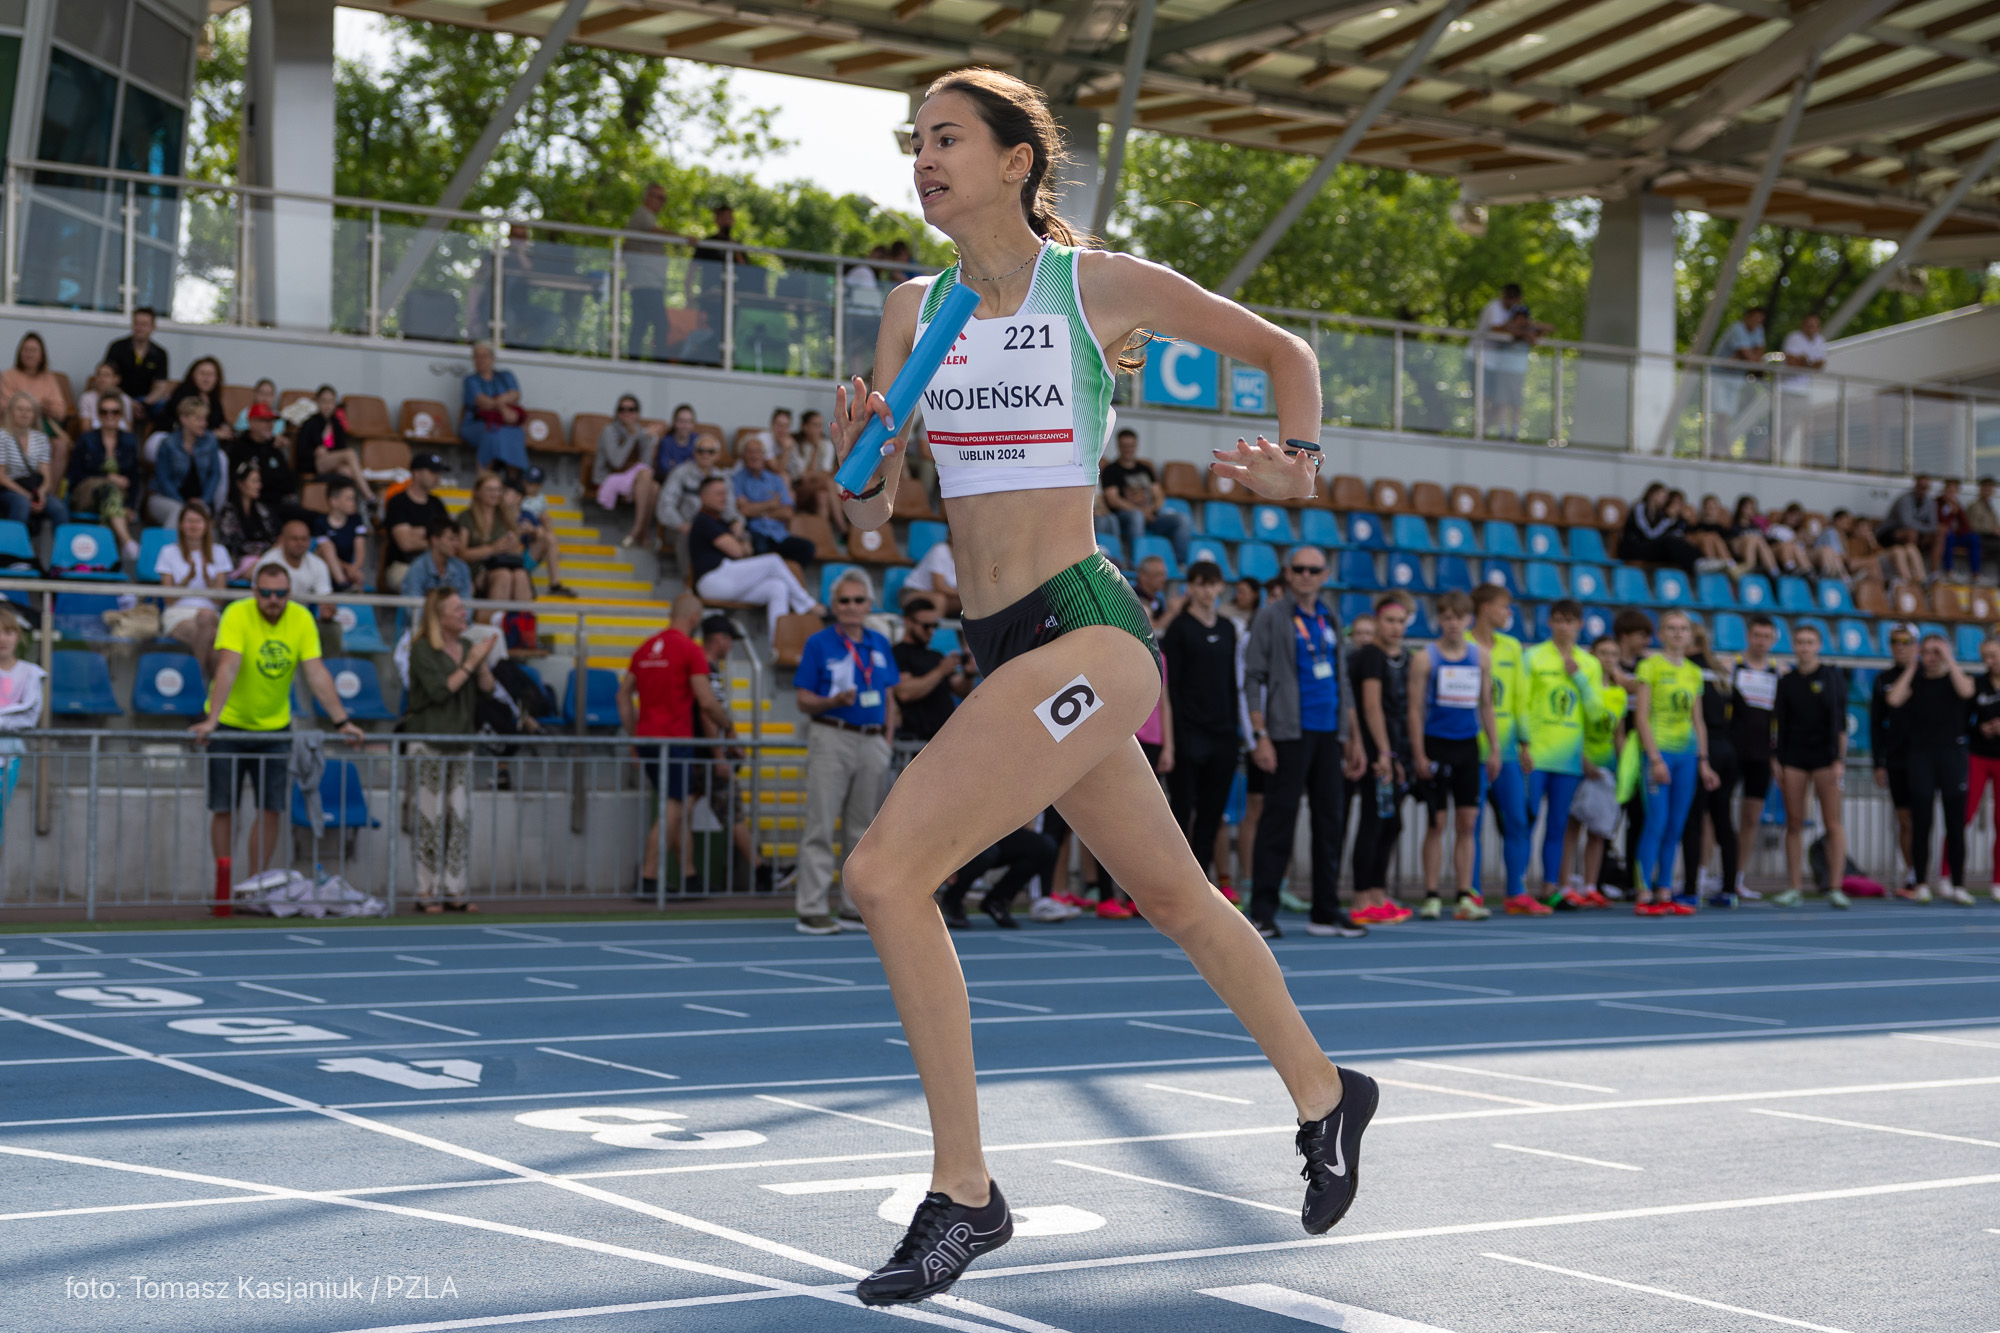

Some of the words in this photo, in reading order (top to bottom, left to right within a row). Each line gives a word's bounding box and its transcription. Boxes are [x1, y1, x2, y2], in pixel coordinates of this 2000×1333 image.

[1003, 324, 1054, 350] 221
[942, 355, 967, 364] LEN
[1160, 339, 1202, 401] C
[923, 381, 1064, 411] WOJEŃSKA
[1029, 432, 1069, 440] MIESZANYCH
[959, 449, 995, 461] LUBLIN
[997, 449, 1026, 460] 2024
[1050, 684, 1095, 726] 6
[167, 1016, 352, 1044] 5
[316, 1056, 483, 1090] 4
[514, 1106, 768, 1150] 3
[921, 1222, 987, 1286] AIR
